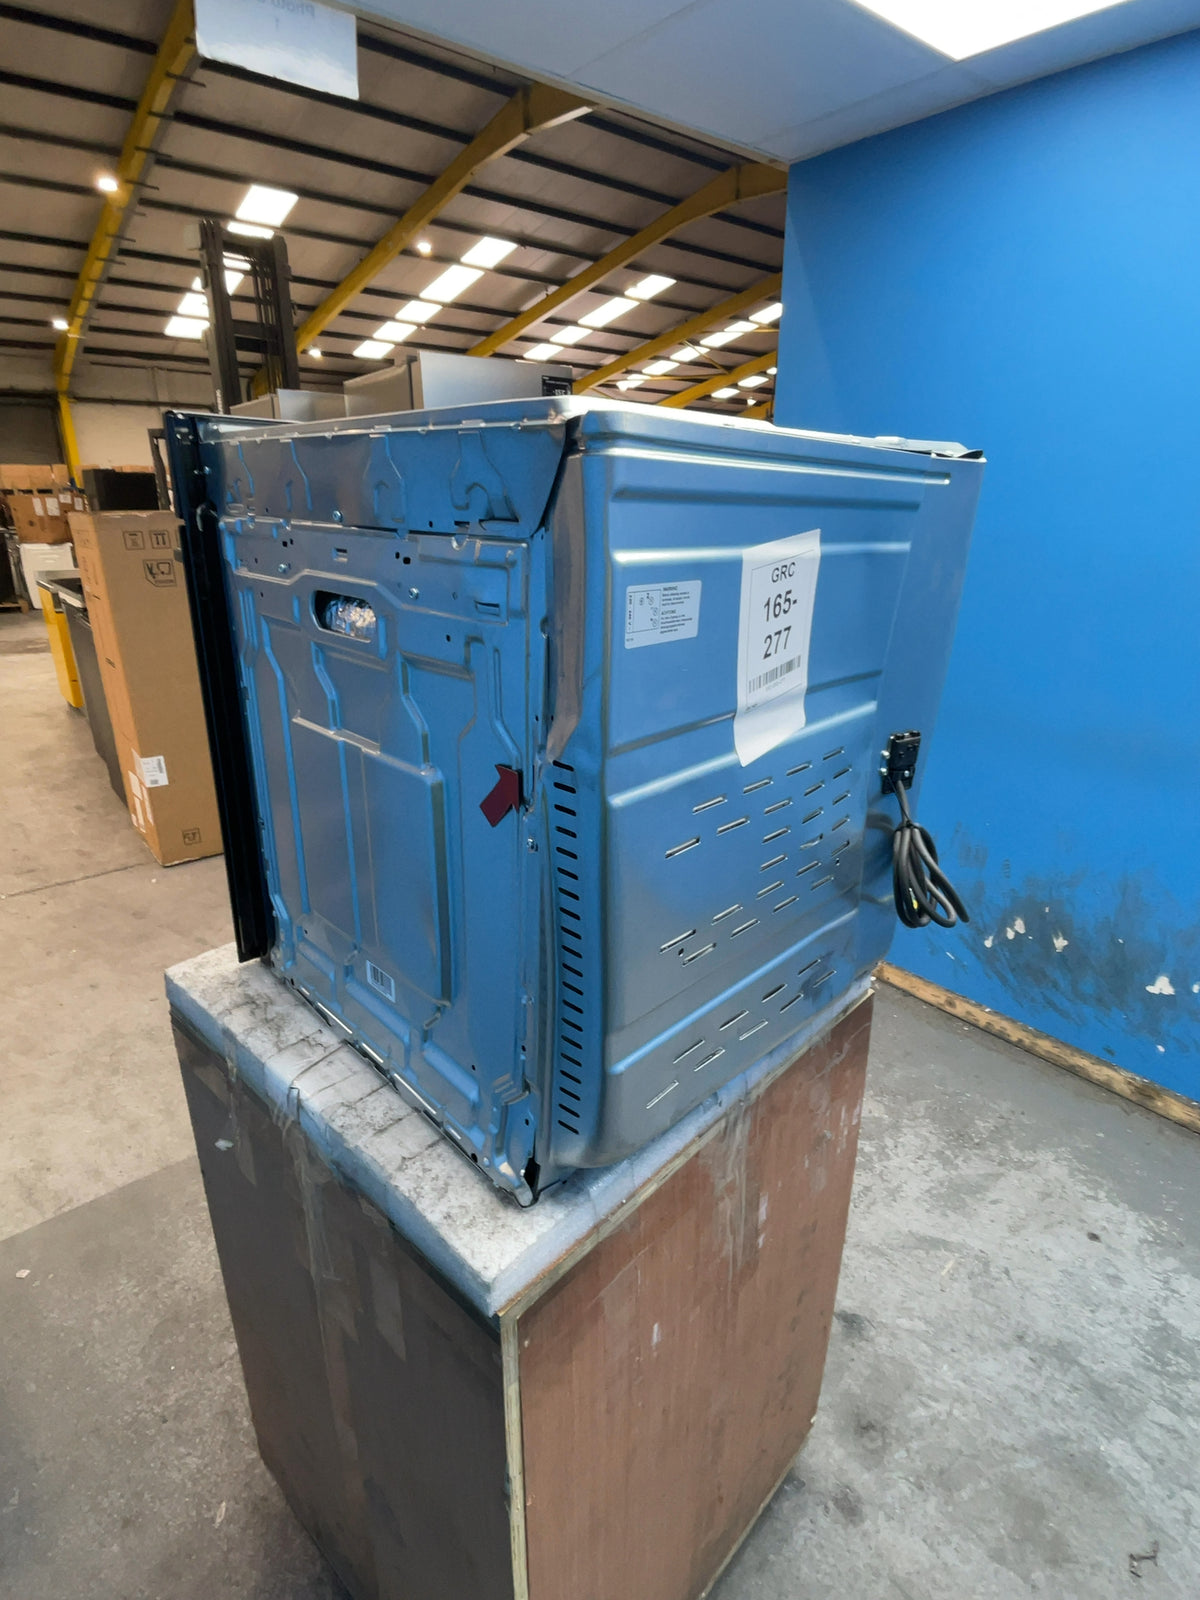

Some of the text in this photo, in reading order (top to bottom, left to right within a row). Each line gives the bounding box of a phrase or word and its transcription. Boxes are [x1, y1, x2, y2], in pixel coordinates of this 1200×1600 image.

[771, 562, 796, 583] GRC
[763, 589, 798, 622] 165-
[763, 625, 792, 660] 277
